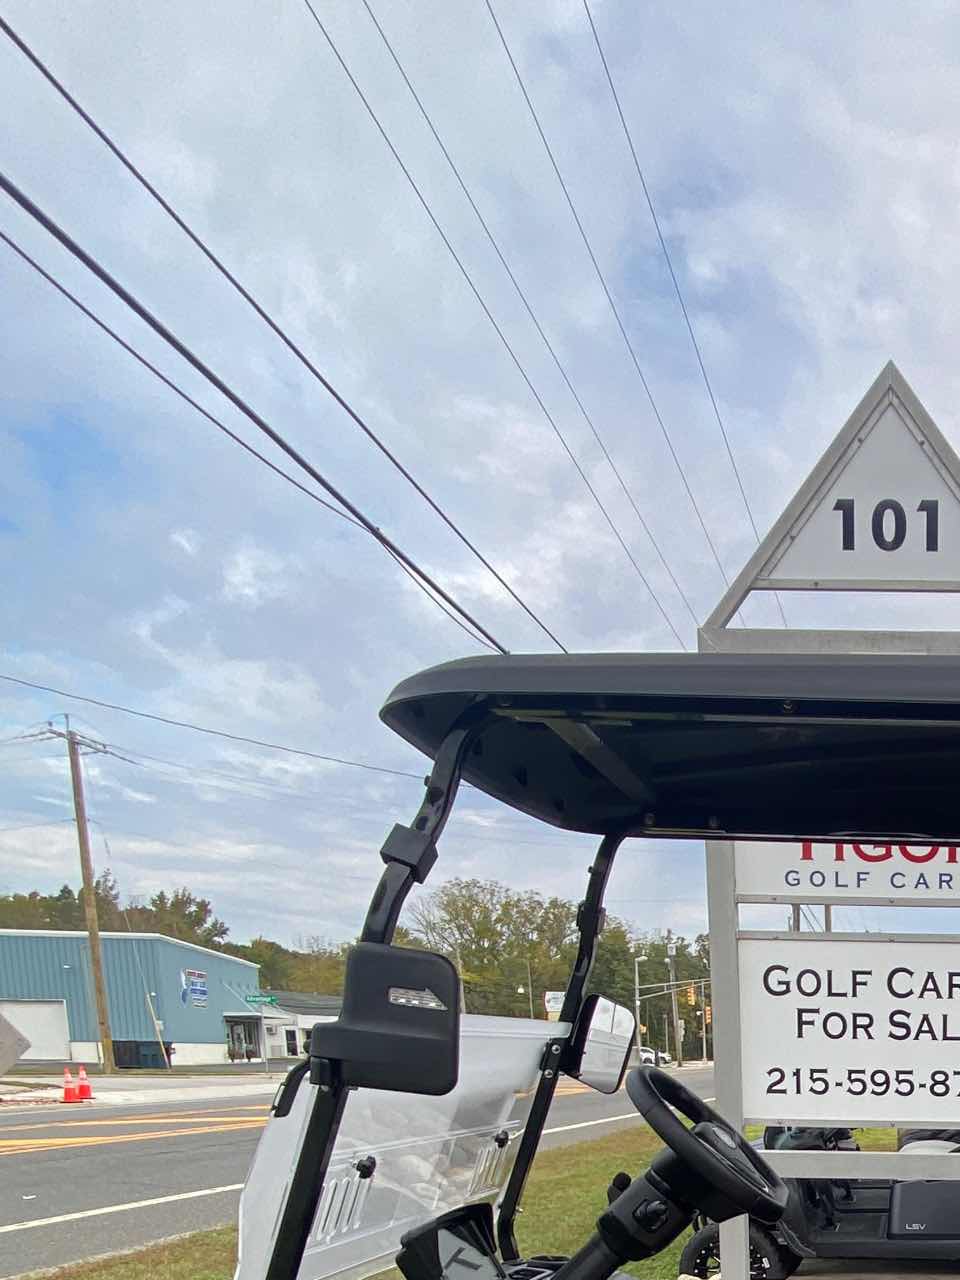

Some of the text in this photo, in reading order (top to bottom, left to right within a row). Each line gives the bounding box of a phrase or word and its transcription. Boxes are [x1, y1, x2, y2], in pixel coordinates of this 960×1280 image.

[832, 498, 939, 552] 101
[784, 870, 871, 888] GOLF
[762, 964, 872, 998] GOLF
[796, 1007, 875, 1040] FOR
